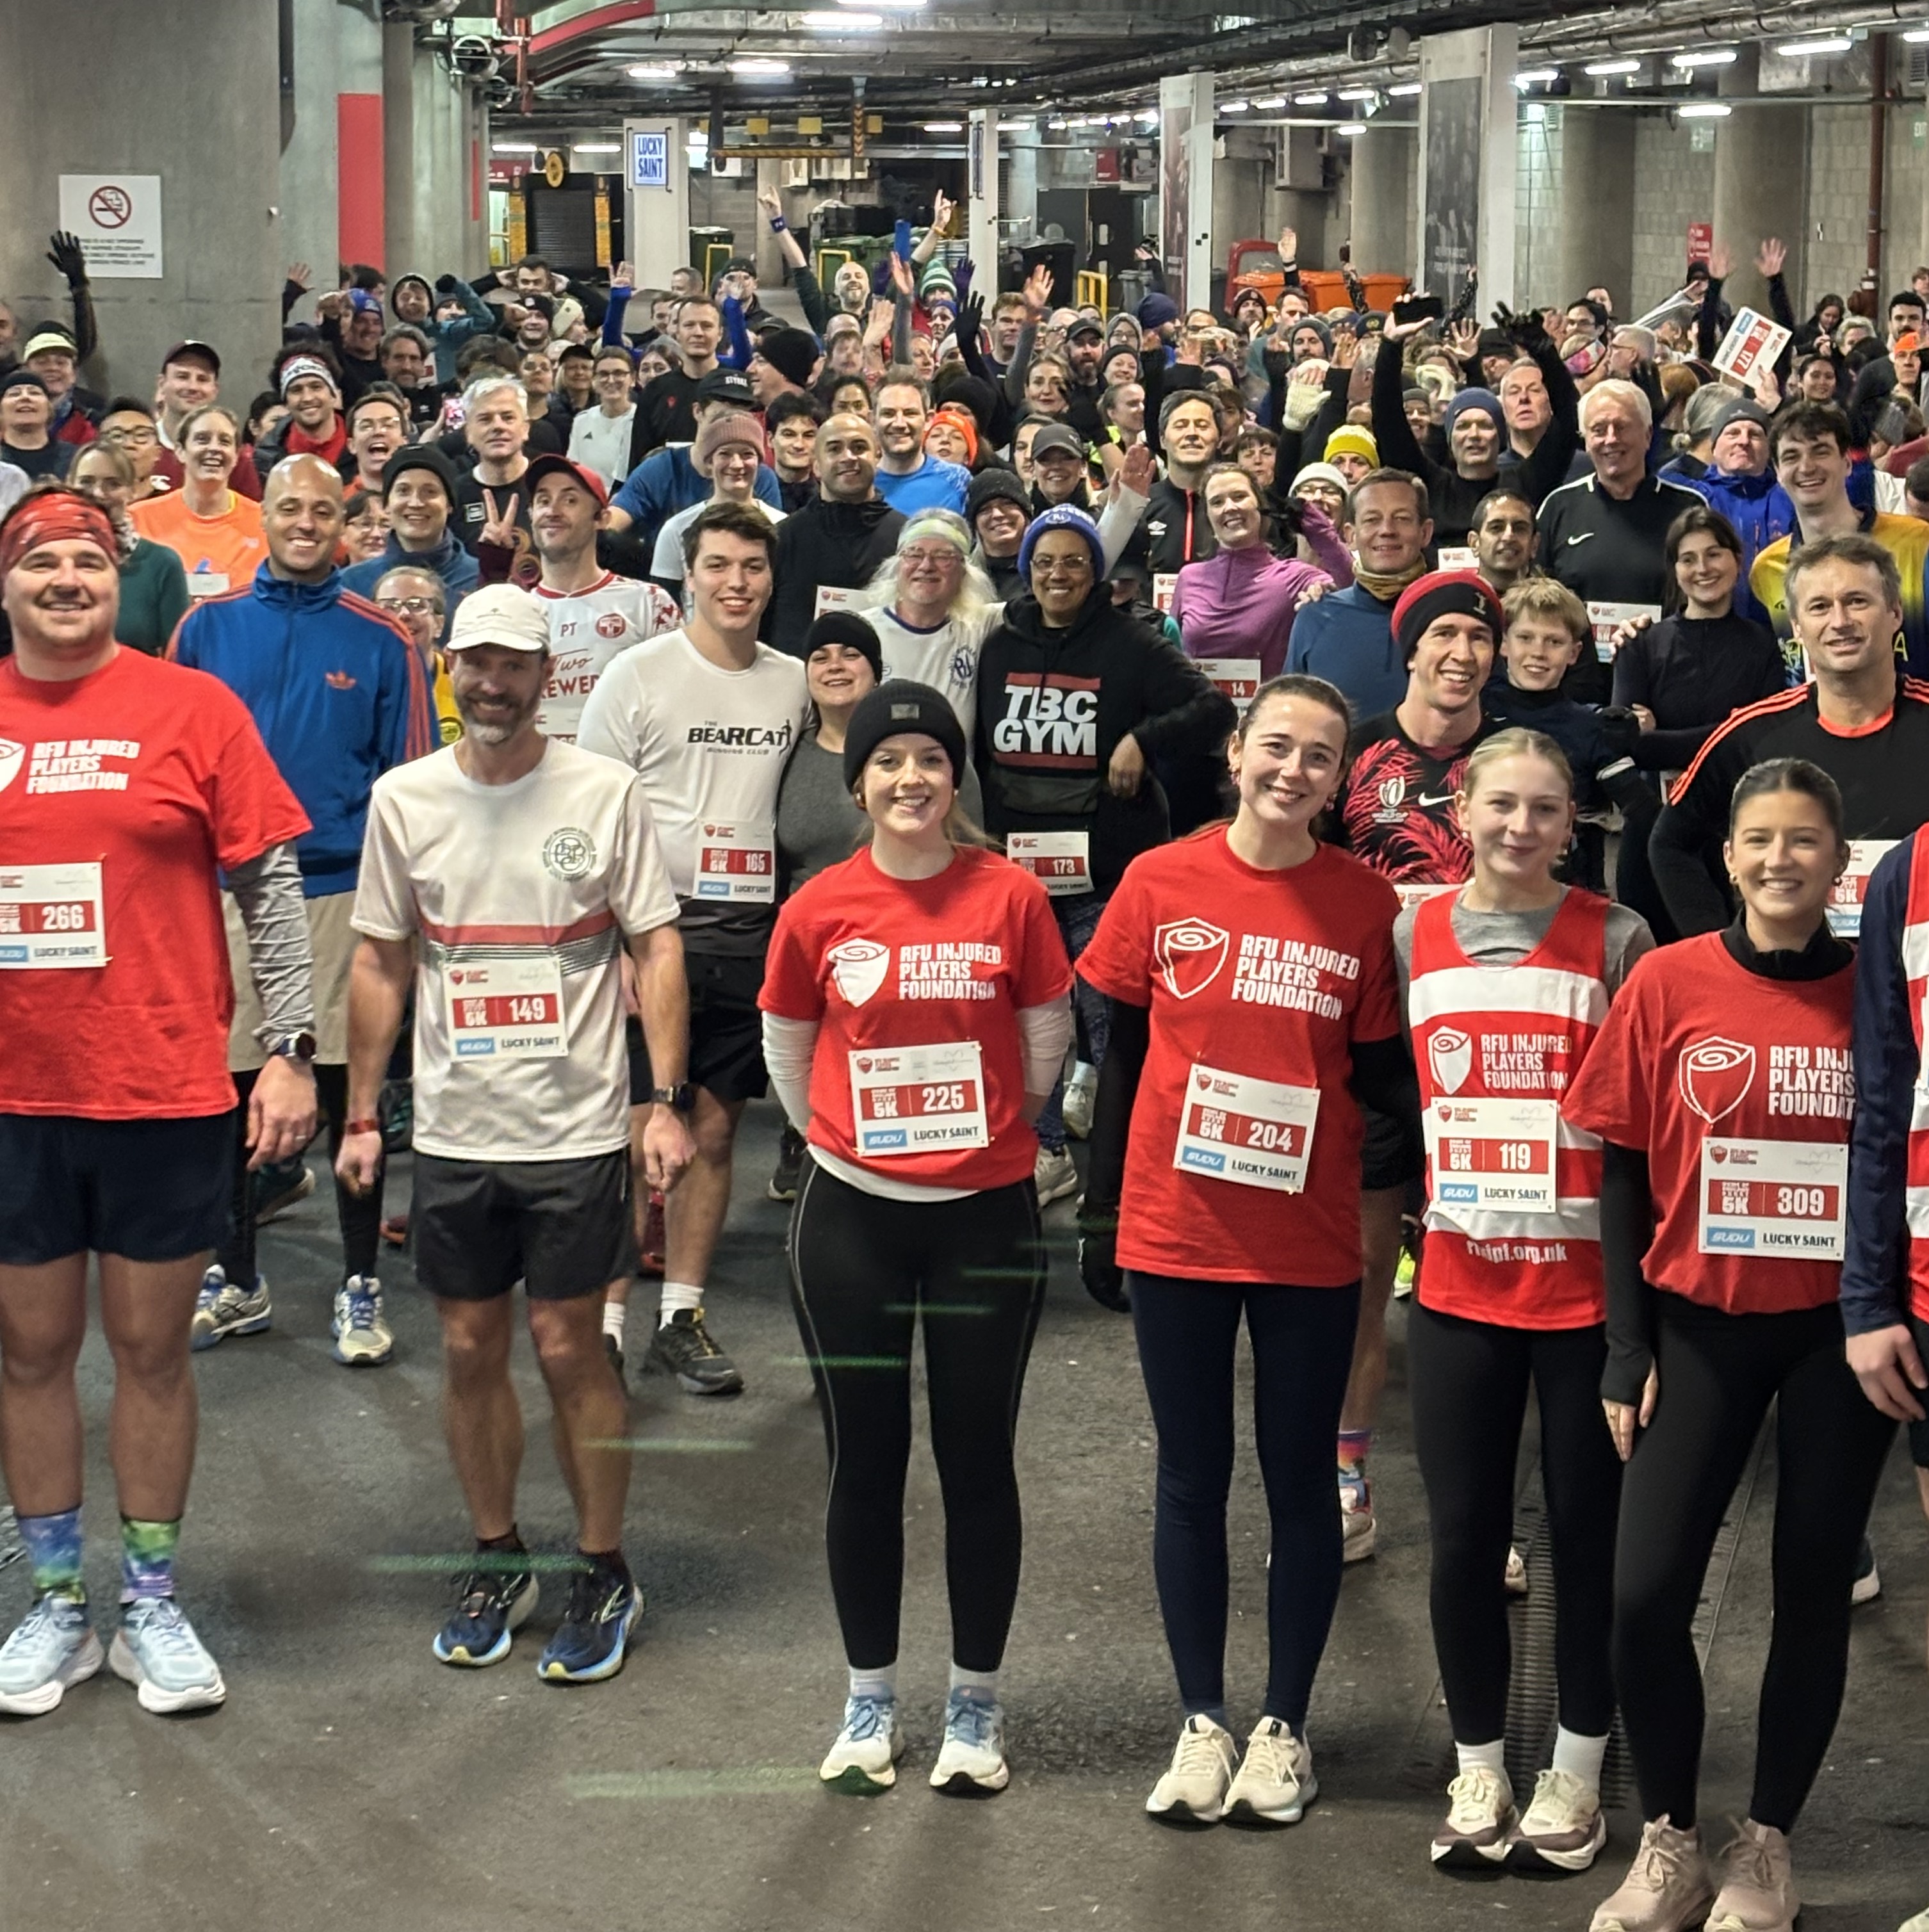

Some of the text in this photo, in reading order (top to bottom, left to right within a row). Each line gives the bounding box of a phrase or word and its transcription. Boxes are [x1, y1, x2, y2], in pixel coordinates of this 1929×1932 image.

[638, 137, 663, 155] LUCKY
[638, 158, 663, 178] SAINT
[560, 622, 578, 637] PT
[1232, 681, 1245, 697] 14
[1005, 685, 1098, 724] TBC
[993, 718, 1096, 756] GYM
[68, 739, 141, 759] INJURED
[29, 755, 102, 775] PLAYERS
[26, 772, 129, 794] FOUNDATION
[42, 904, 86, 930] 266
[899, 942, 1002, 965] RFU INJURED
[1239, 934, 1361, 980] RFU INJURED
[899, 961, 972, 980] PLAYERS
[1235, 956, 1319, 989] PLAYERS
[509, 997, 546, 1022] 149
[1231, 977, 1343, 1021] FOUNDATION
[501, 1038, 532, 1048] LUCKY
[1480, 1034, 1572, 1053] RFU INJURED
[1481, 1053, 1544, 1071] PLAYERS
[1769, 1045, 1809, 1069] RFU
[1483, 1071, 1569, 1090] FOUNDATION
[1768, 1068, 1855, 1096] PLAYERS
[873, 1101, 899, 1118] 5K
[922, 1085, 964, 1112] 225
[913, 1125, 979, 1141] LUCKY SAINT
[1199, 1121, 1293, 1153] 5K 204
[1449, 1153, 1472, 1171] 5K
[1499, 1142, 1531, 1171] 119
[1231, 1159, 1299, 1180] LUCKY SAINT
[1484, 1187, 1548, 1201] LUCKY SAINT
[1721, 1197, 1750, 1215] 5K
[1777, 1187, 1825, 1217] 309
[1762, 1232, 1836, 1248] LUCKY SAINT
